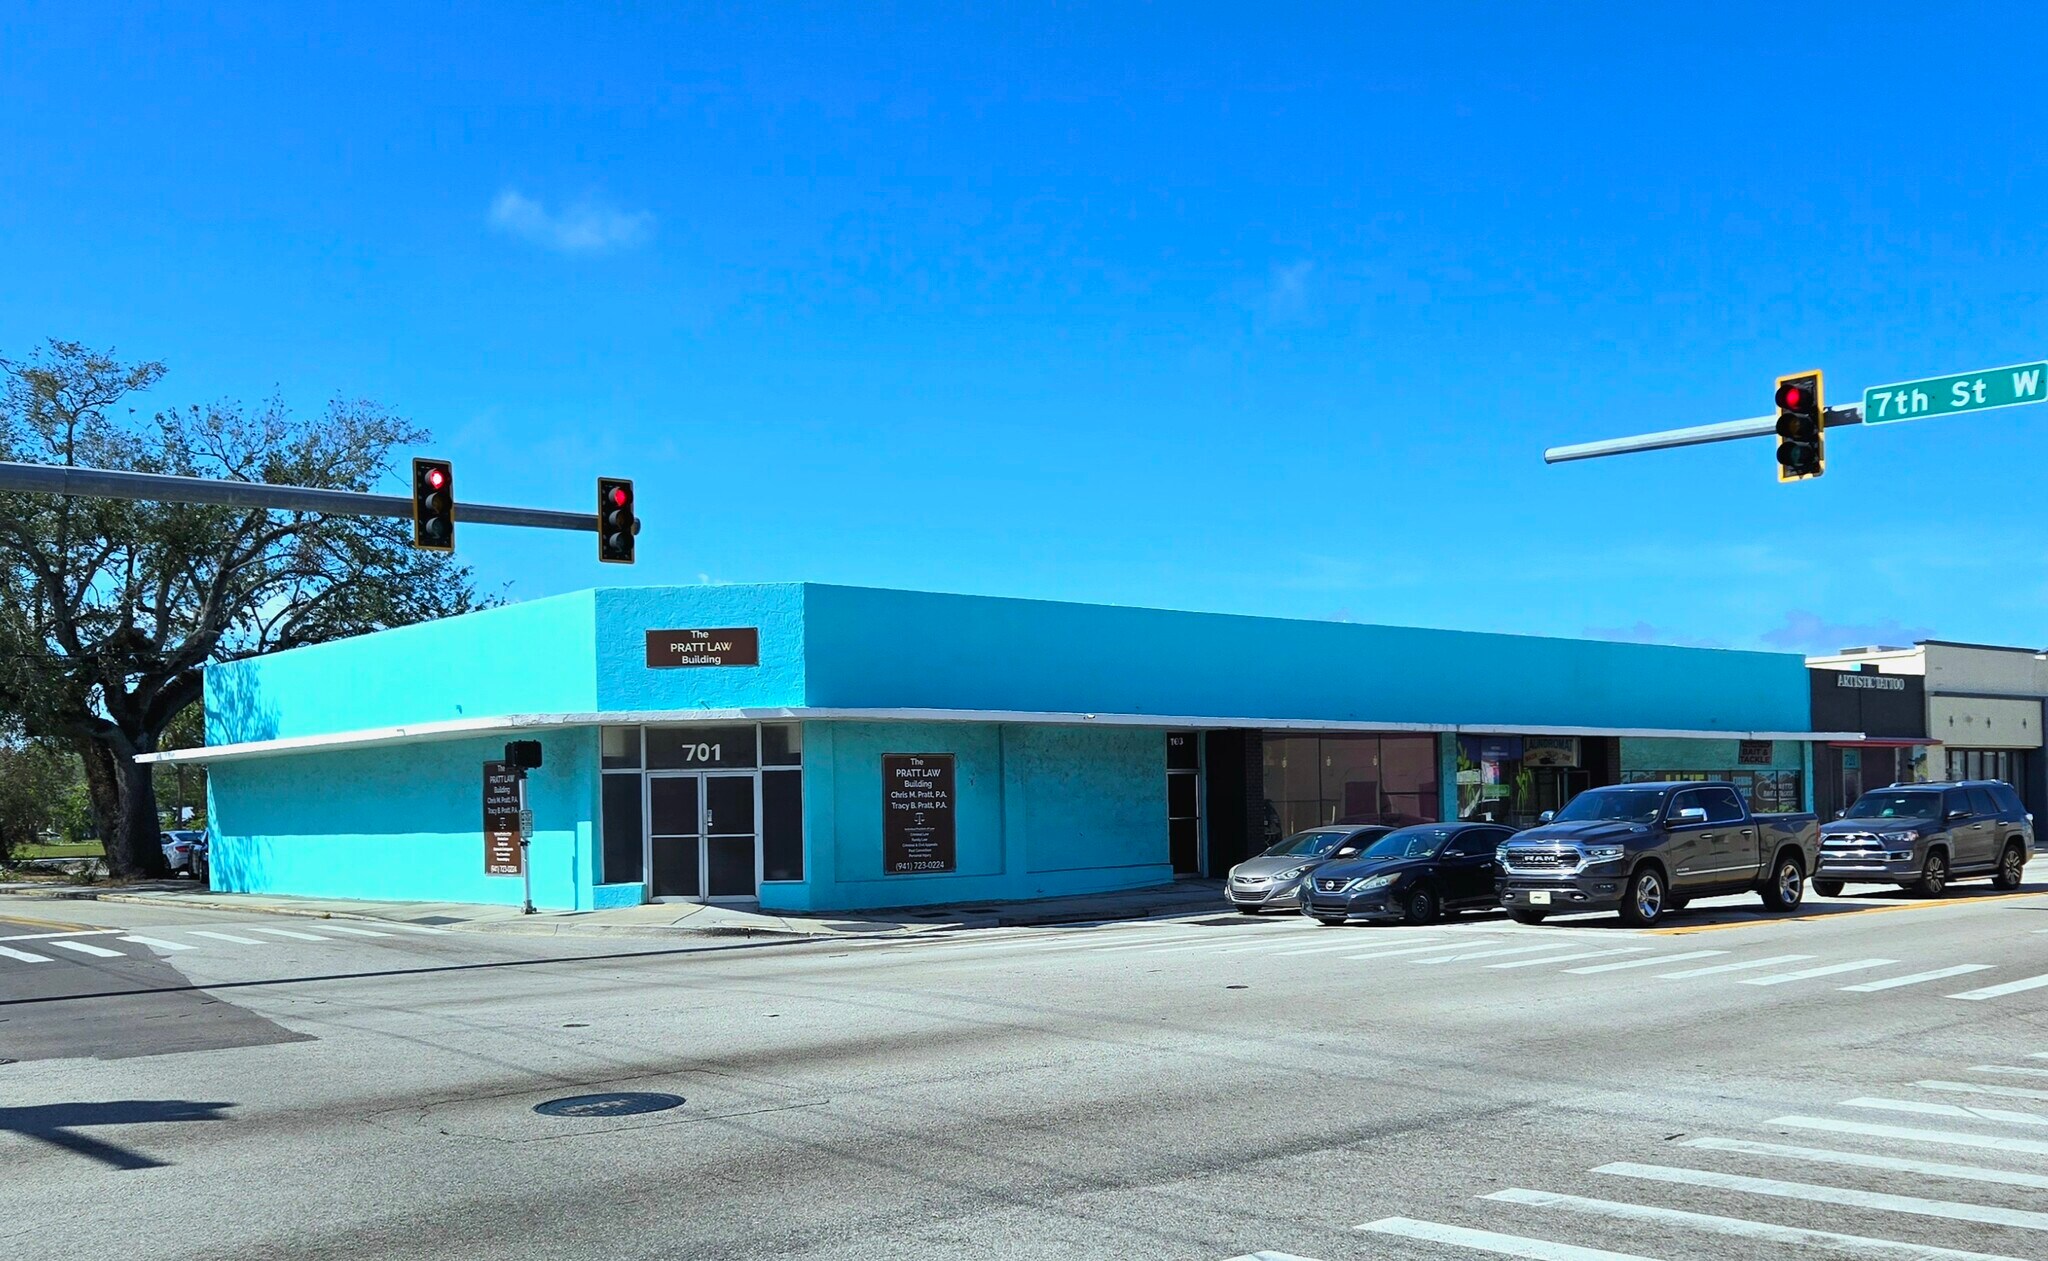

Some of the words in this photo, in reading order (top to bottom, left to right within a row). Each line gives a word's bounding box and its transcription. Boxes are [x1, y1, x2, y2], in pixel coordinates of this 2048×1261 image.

[1872, 388, 1928, 417] 7th
[1951, 378, 1987, 407] St
[2012, 369, 2040, 398] W
[691, 630, 709, 638] The
[670, 643, 705, 652] PRATT
[707, 642, 732, 651] LAW
[682, 655, 721, 665] Building
[1837, 674, 1876, 688] ARTISTIC
[1876, 677, 1905, 690] TATTOO
[682, 743, 720, 761] 701
[896, 769, 921, 777] PRATT
[922, 768, 941, 777] LAW
[904, 780, 932, 789] Building
[891, 802, 909, 810] Tracy
[895, 862, 912, 871] (941)
[913, 861, 944, 869] 723-0224
